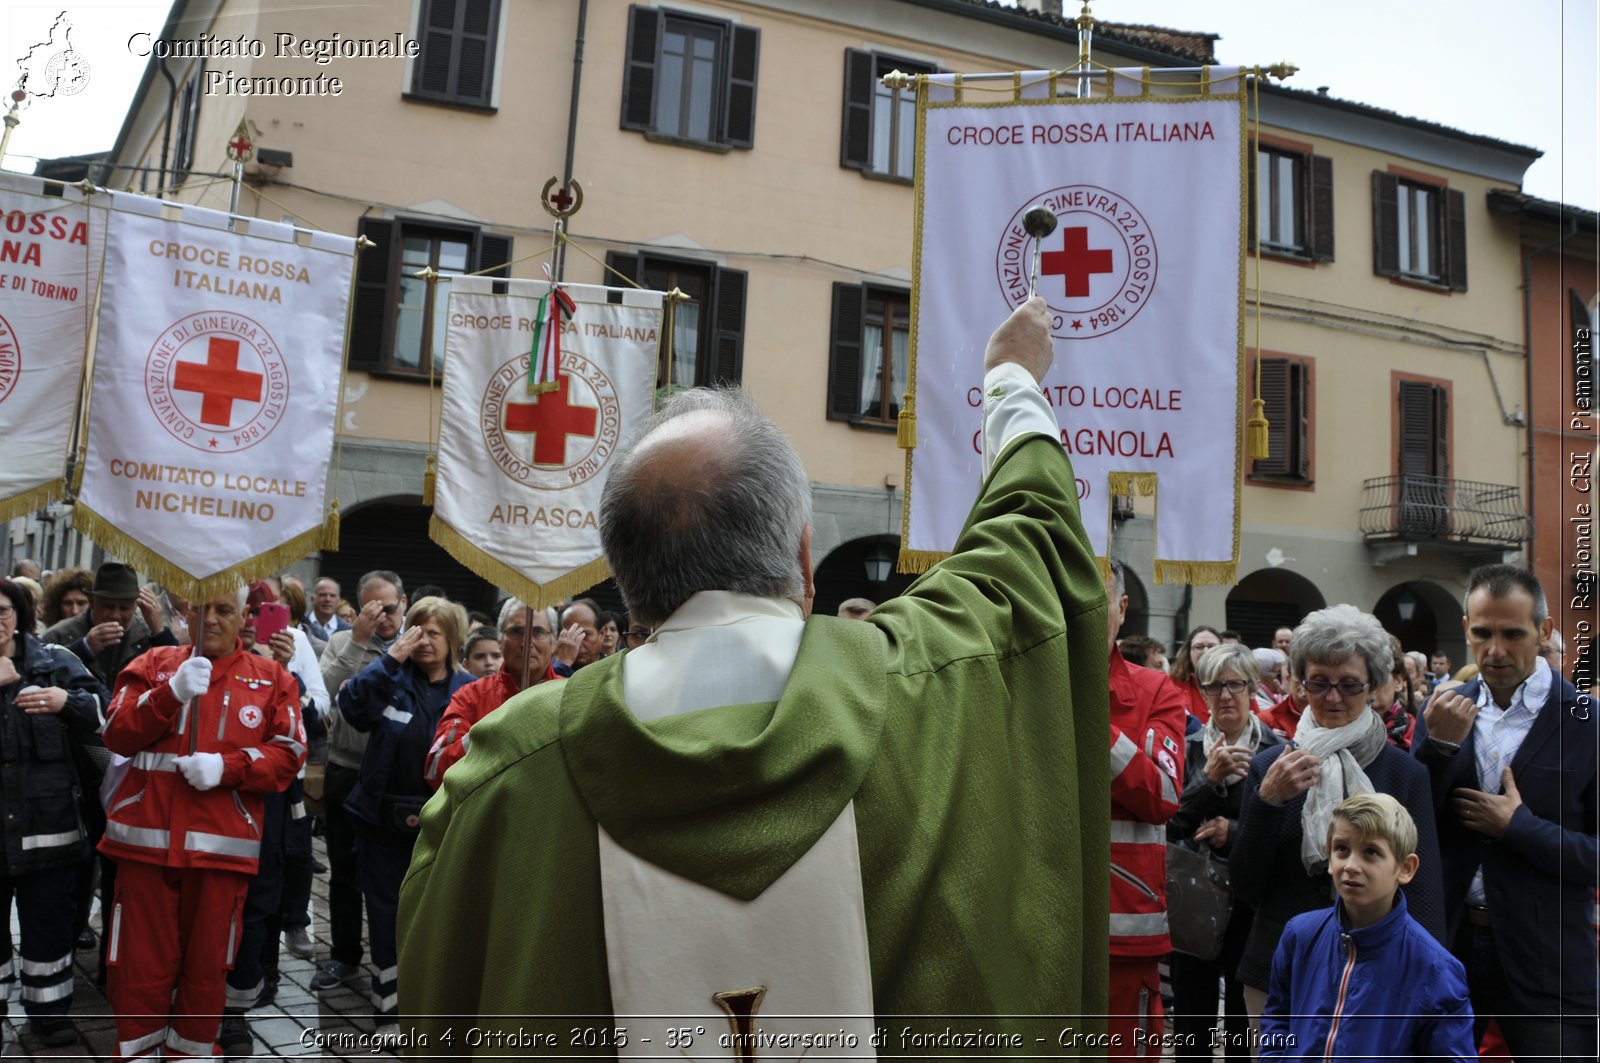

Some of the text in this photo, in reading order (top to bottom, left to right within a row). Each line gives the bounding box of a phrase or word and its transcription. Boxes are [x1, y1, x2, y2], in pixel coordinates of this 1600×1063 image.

[947, 121, 1215, 146] CROCE ROSSA ITALIANA
[1043, 191, 1118, 217] GINEVRA
[0, 208, 88, 247] OSSA
[1117, 211, 1138, 232] 22
[149, 239, 310, 284] CROCE ROSSA
[1124, 232, 1151, 304] AGOSTO
[12, 275, 26, 291] DI
[31, 278, 78, 302] TORINO
[174, 269, 282, 304] ITALIANA
[451, 313, 657, 342] CROCE ROSA ITALIANA
[1089, 303, 1126, 330] 1864
[150, 316, 284, 447] CONVENZIONE DI GINEVRA 22 AGOSTO 1864
[500, 366, 518, 382] DI
[589, 372, 608, 391] 22
[1093, 386, 1182, 411] LOCALE
[484, 380, 530, 480] CONVENZIONE
[597, 395, 618, 458] AGOSTO
[110, 458, 307, 498] COMITATO LOCALE
[568, 458, 598, 484] 1864
[135, 489, 275, 522] NICHELINO
[488, 504, 599, 530] AIRASCA
